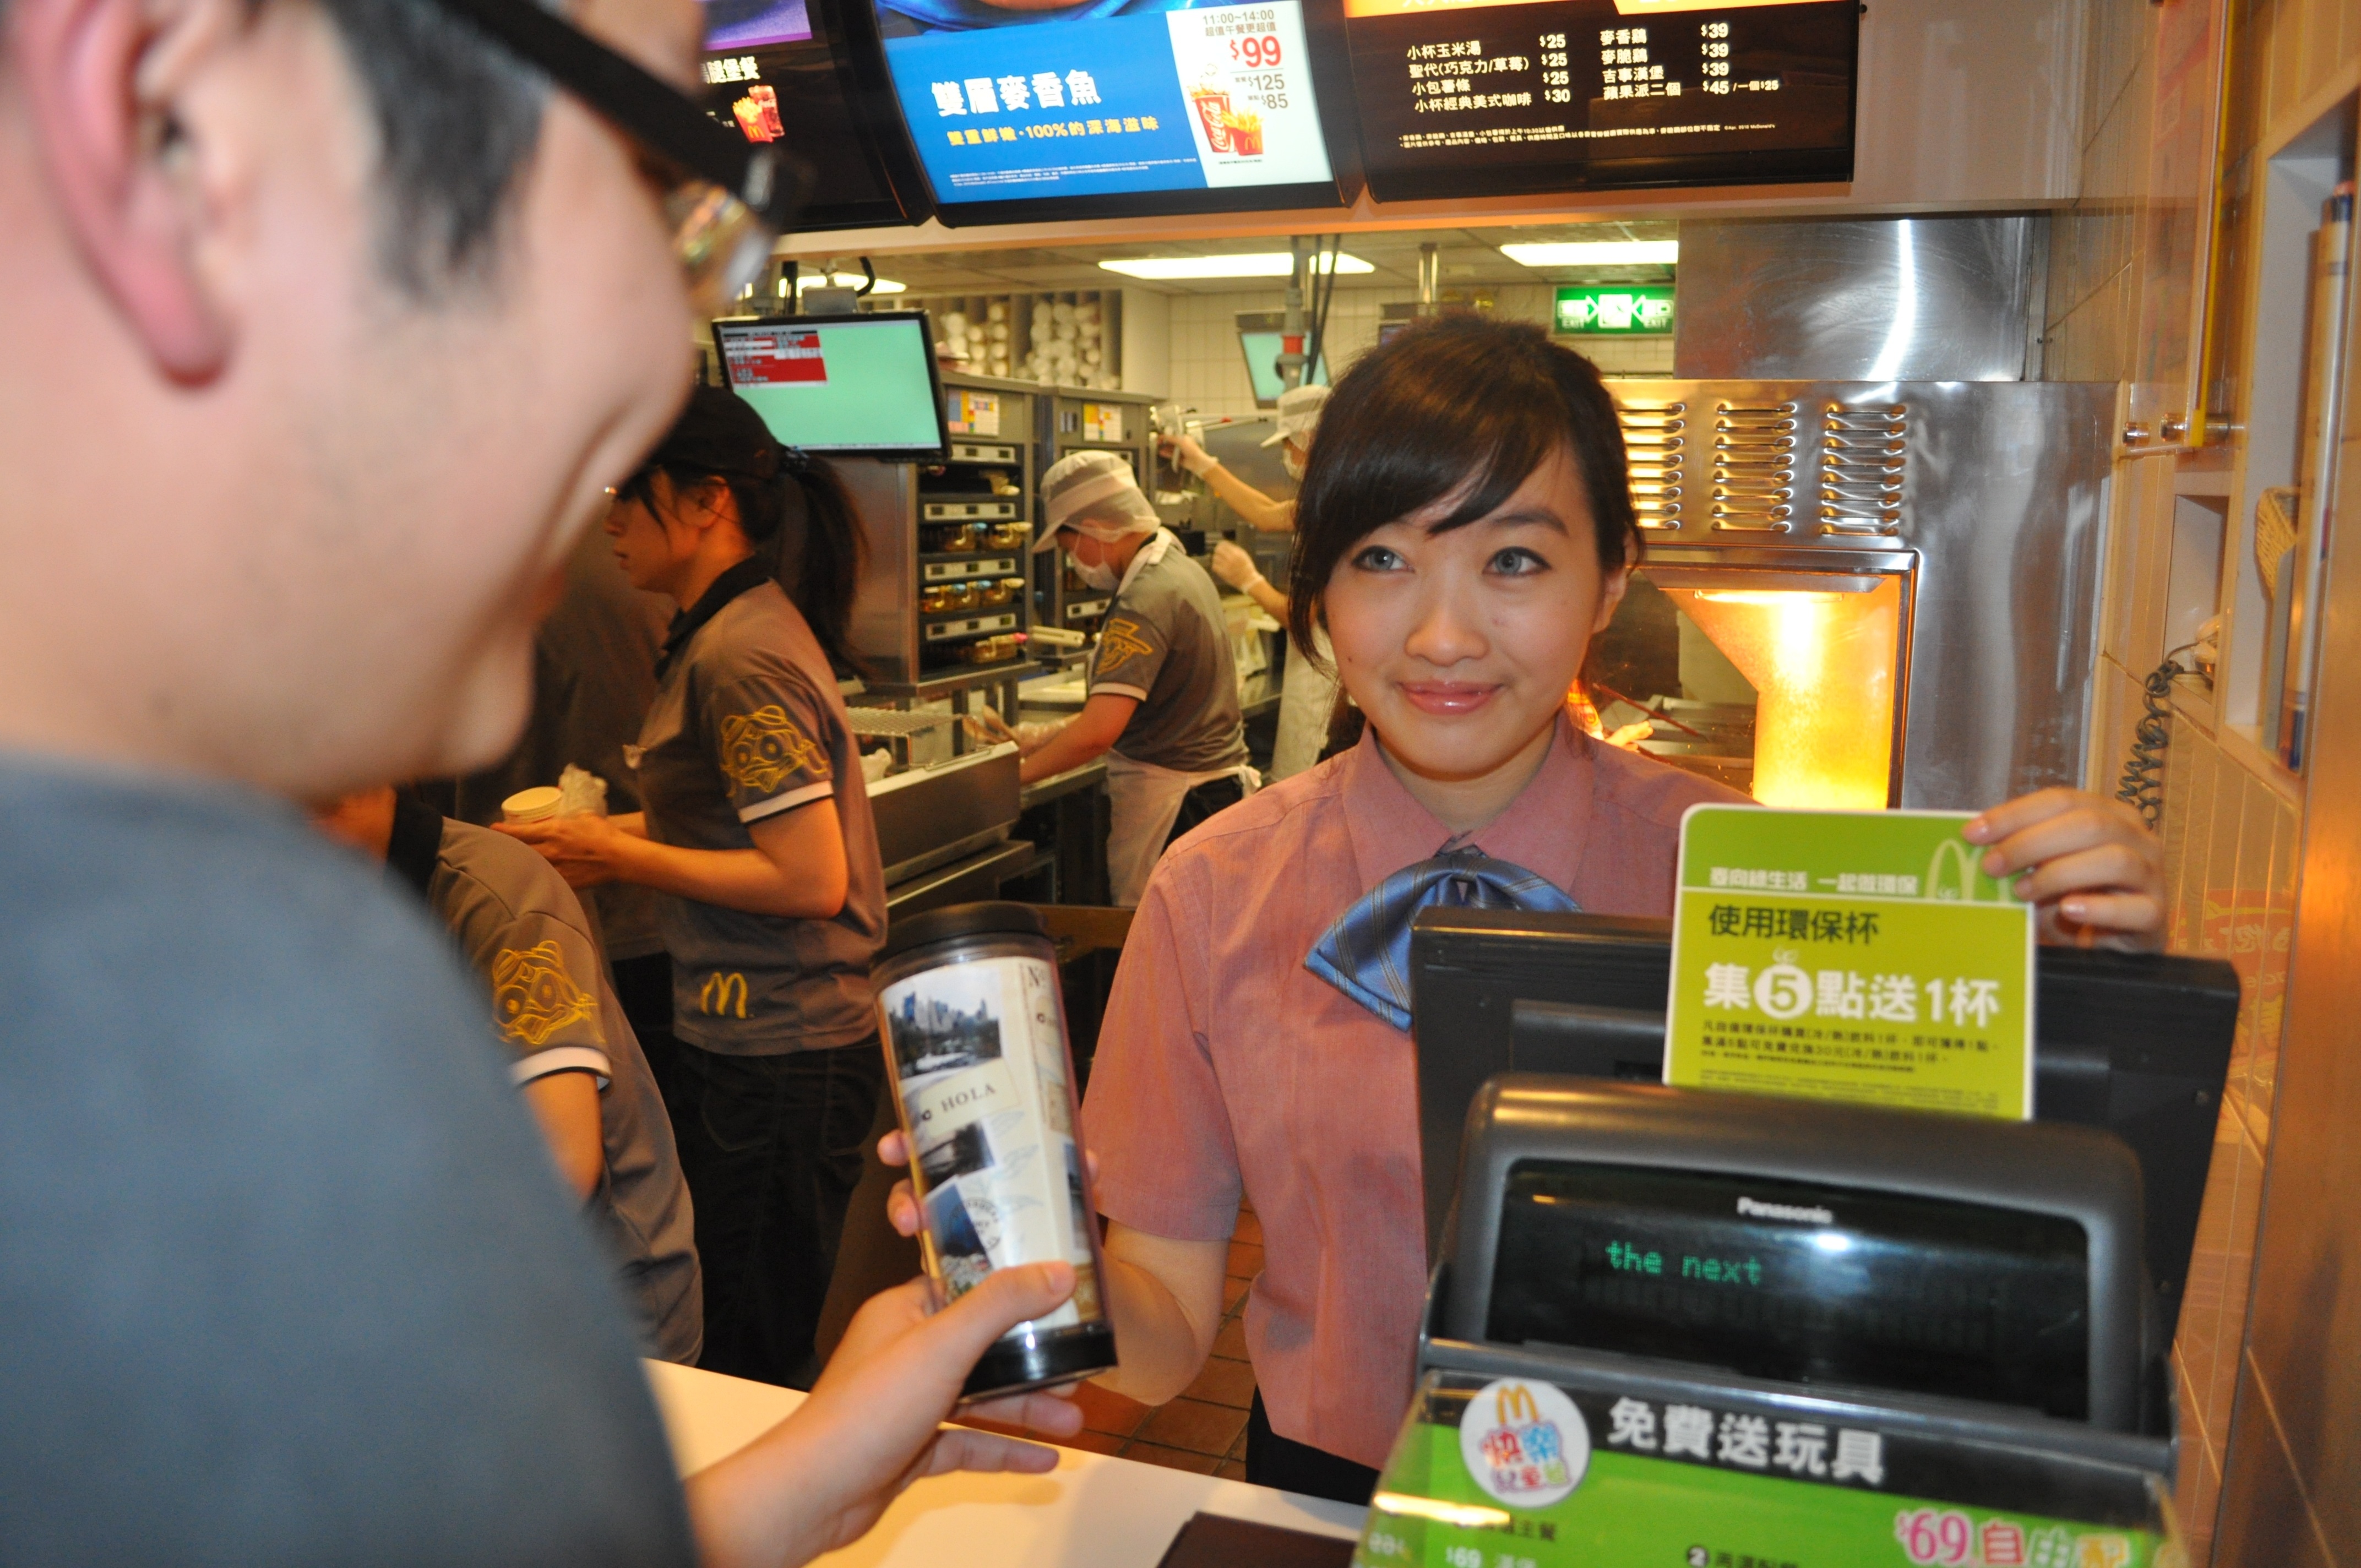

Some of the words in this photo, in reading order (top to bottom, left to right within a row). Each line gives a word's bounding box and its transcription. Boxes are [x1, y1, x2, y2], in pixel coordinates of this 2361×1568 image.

[1203, 9, 1275, 25] 11:00~14:00
[1205, 21, 1277, 37] 超值午餐更超值
[1701, 23, 1728, 39] $39
[1230, 36, 1282, 68] $99
[1407, 40, 1481, 60] 小杯玉米湯
[1539, 34, 1566, 48] $25
[1701, 43, 1729, 58] $39
[1541, 53, 1568, 67] $25
[1248, 74, 1285, 91] $125
[1412, 79, 1471, 96] 小包薯條
[1543, 71, 1569, 85] $25
[1602, 65, 1664, 84] 吉事漢堡
[1702, 62, 1729, 77] $39
[931, 69, 1102, 117] 雙層麥香魚
[1415, 92, 1532, 113] 小杯經典美式咖啡
[1544, 89, 1571, 103] $30
[1603, 82, 1681, 100] 蘋果派二個
[1702, 80, 1729, 95] $45
[1261, 94, 1288, 110] $85
[1709, 904, 1879, 945] 使用環保杯
[941, 1082, 996, 1112] HOLA
[1605, 1240, 1662, 1274] the
[1682, 1255, 1762, 1286] next
[1607, 1395, 1885, 1484] 免費送玩具
